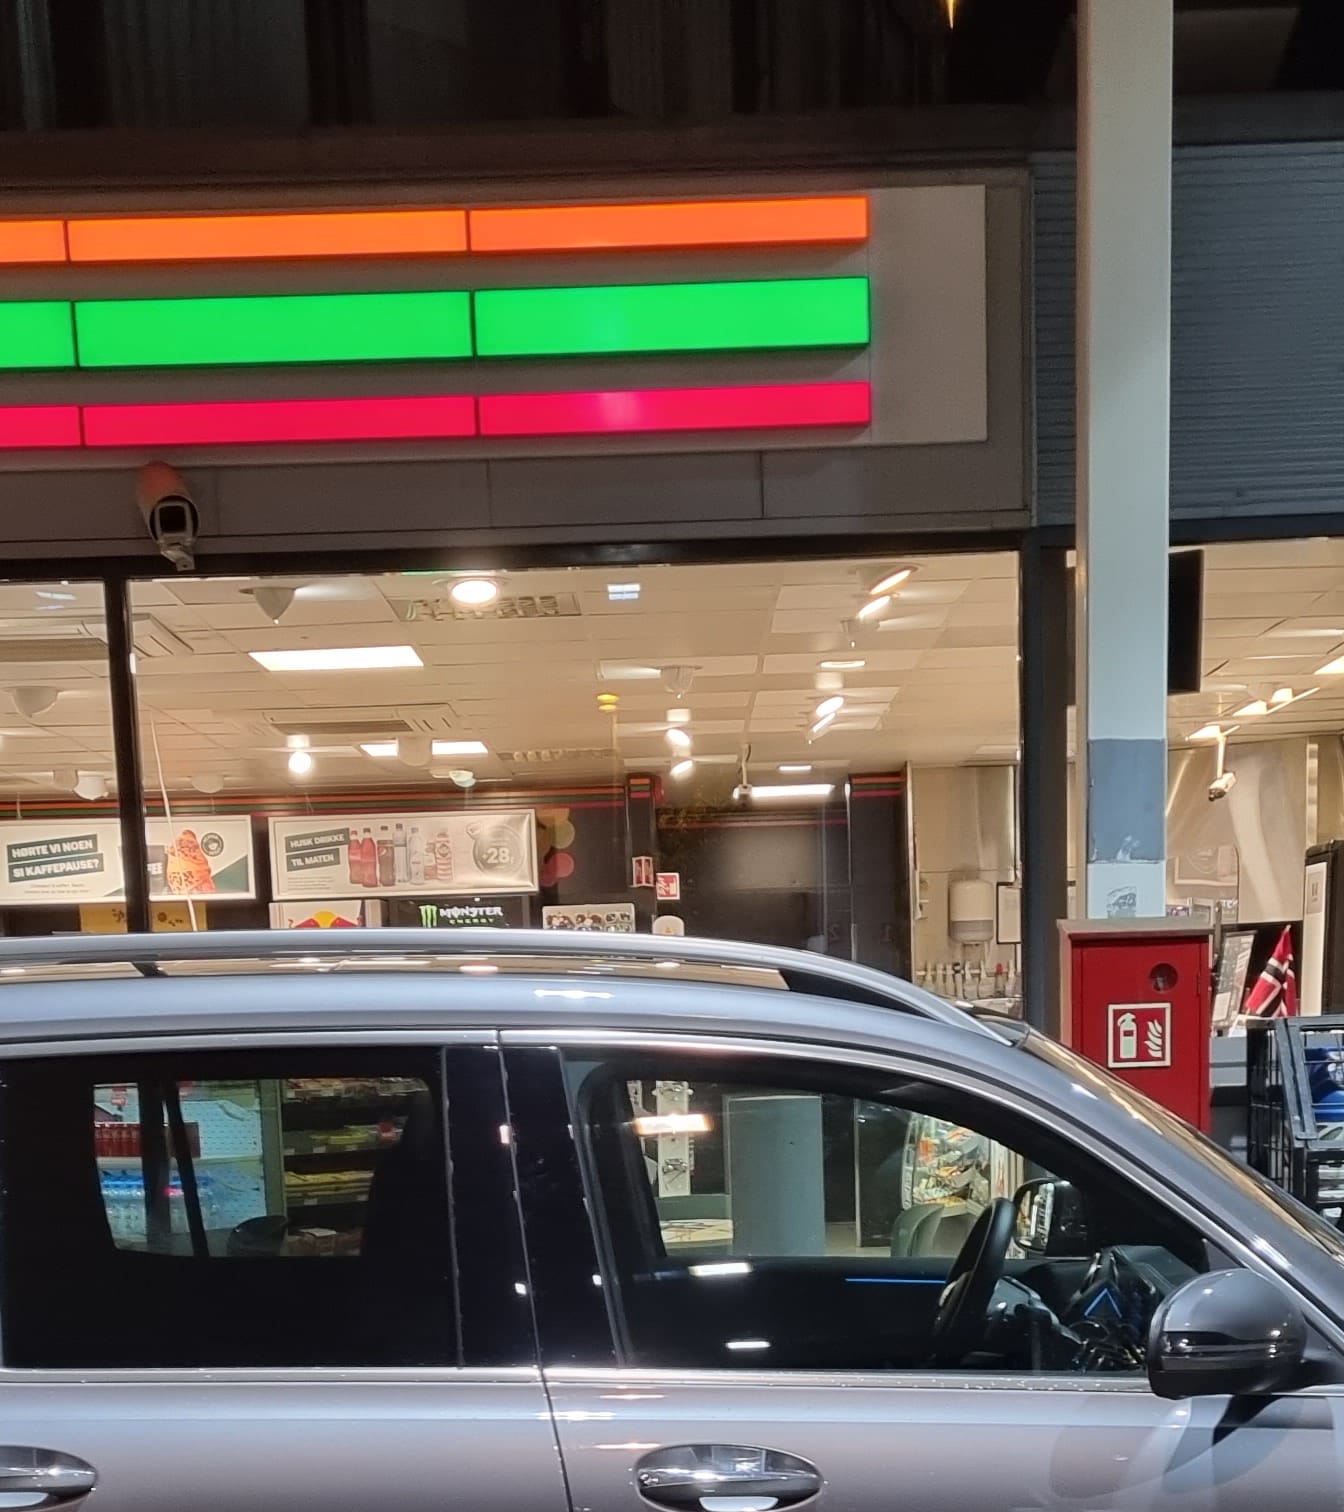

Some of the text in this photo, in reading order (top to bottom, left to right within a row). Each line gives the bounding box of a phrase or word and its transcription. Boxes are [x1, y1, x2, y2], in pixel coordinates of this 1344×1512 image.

[11, 839, 93, 858] HØRTE VI NOEN
[13, 858, 99, 877] SI KAFFEPAUSE?
[290, 854, 334, 867] TIL MATEN
[439, 905, 504, 918] MONSTER
